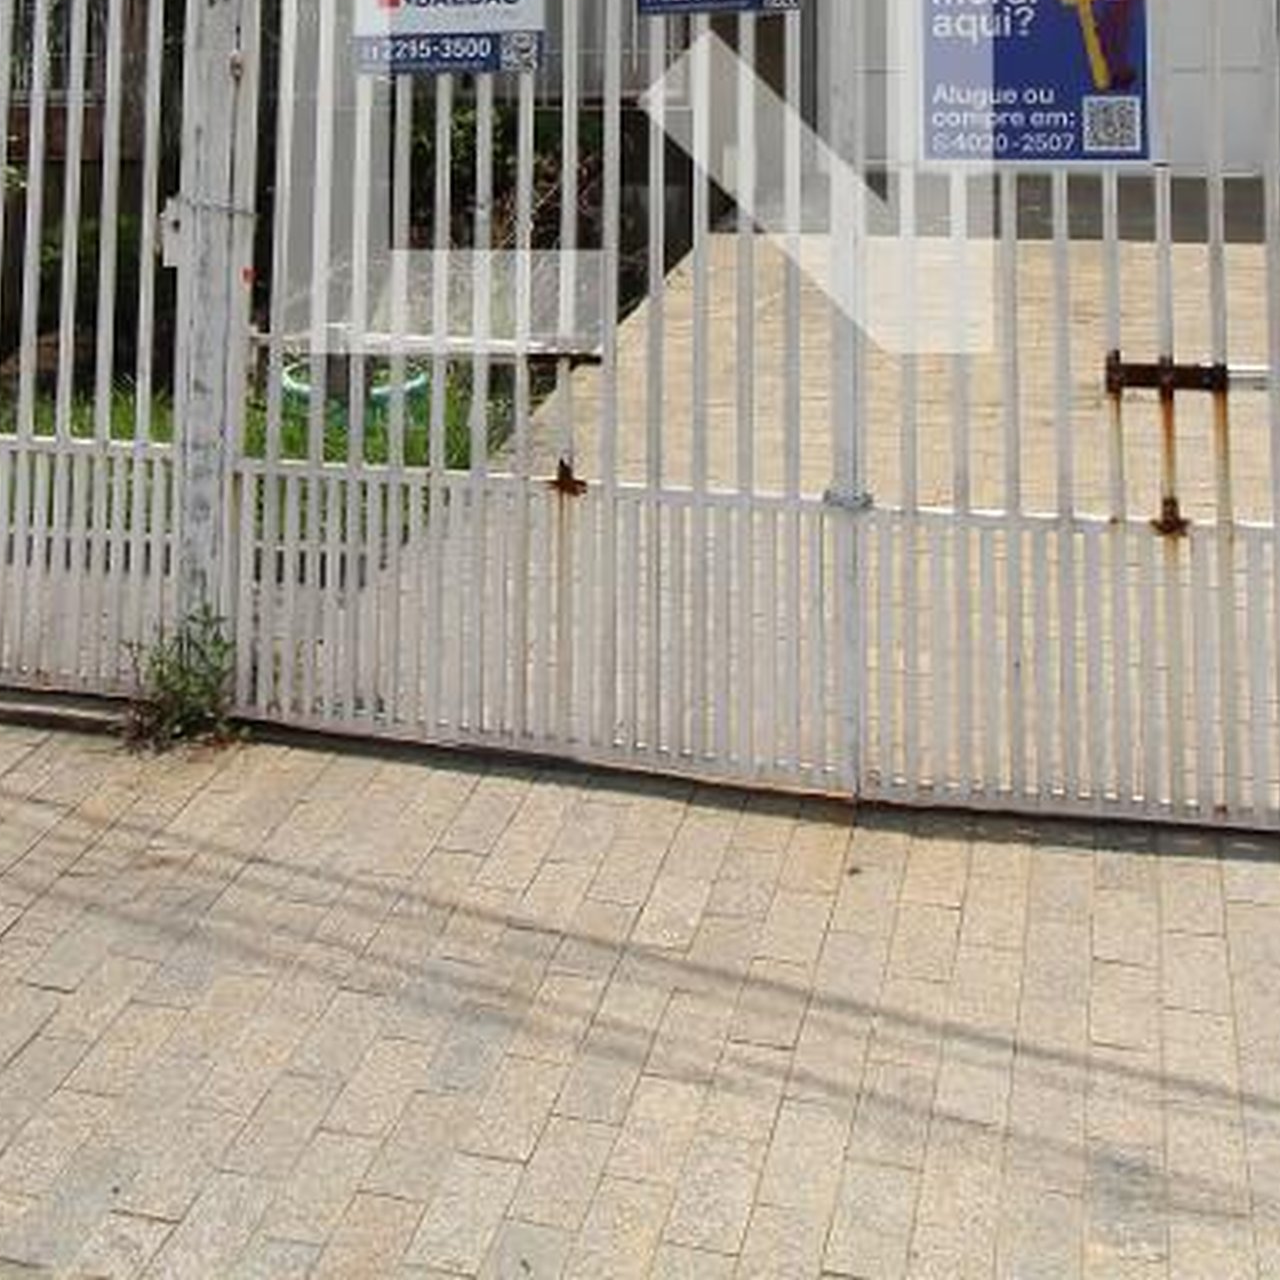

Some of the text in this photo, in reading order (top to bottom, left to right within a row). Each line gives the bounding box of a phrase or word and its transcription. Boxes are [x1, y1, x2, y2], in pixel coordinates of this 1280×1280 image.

[932, 6, 1035, 45] aqui?
[932, 83, 1055, 110] Alugue ou
[932, 111, 1075, 131] compre em:
